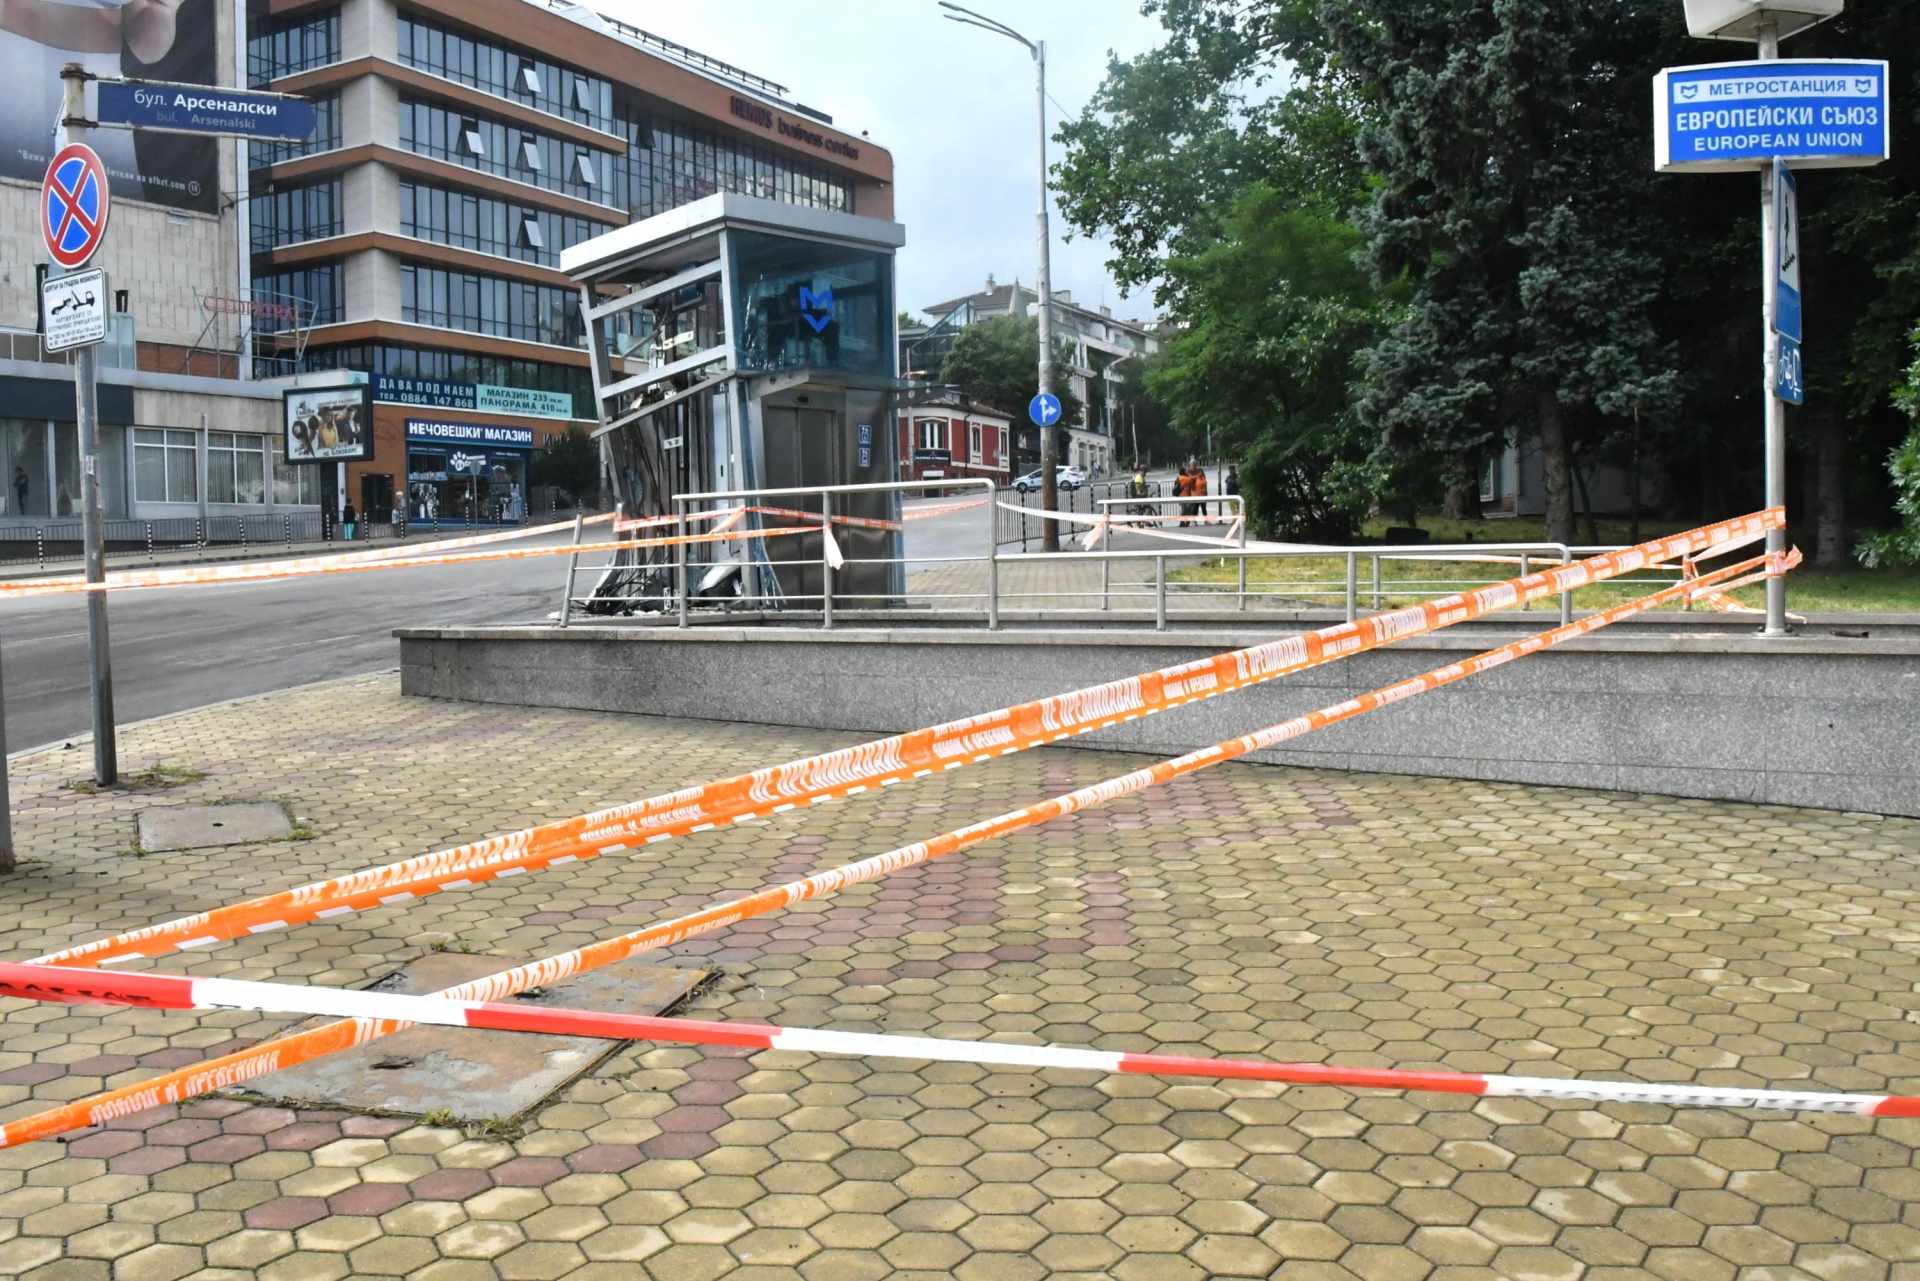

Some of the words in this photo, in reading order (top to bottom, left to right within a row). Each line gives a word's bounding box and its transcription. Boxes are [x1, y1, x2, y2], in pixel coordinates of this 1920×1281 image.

[1709, 80, 1846, 96] МЕТРОСТАНЦИЯ
[134, 89, 167, 108] бул.
[173, 94, 277, 116] Арсеналски
[156, 111, 178, 123] bul.
[191, 115, 255, 129] Arsenalski
[730, 95, 773, 129] HEMUS
[778, 116, 823, 147] business
[824, 138, 860, 160] center
[1676, 104, 1813, 131] ЕВРОПЕЙСКИ
[1821, 106, 1878, 126] СЪЮЗ
[1694, 133, 1800, 151] EUROPEAN
[1806, 132, 1863, 147] UNION
[416, 382, 440, 394] ПОД
[444, 385, 474, 397] НАЕМ
[486, 388, 529, 400] МАГАЗИН
[533, 393, 548, 402] 233
[379, 392, 398, 401] тел.
[400, 393, 428, 404] 0884
[433, 395, 451, 405] 147
[454, 397, 474, 408] 868
[480, 397, 537, 410] ПАНОРАМА
[540, 403, 555, 411] 410
[409, 422, 480, 439] НЕЧОВЕШКИ
[484, 428, 532, 443] МАГАЗИН
[1038, 697, 1061, 732] НЕ
[749, 771, 780, 803] НЕ
[163, 1079, 180, 1102] И
[184, 1049, 281, 1098] ПРЕВЕНЦИЯ
